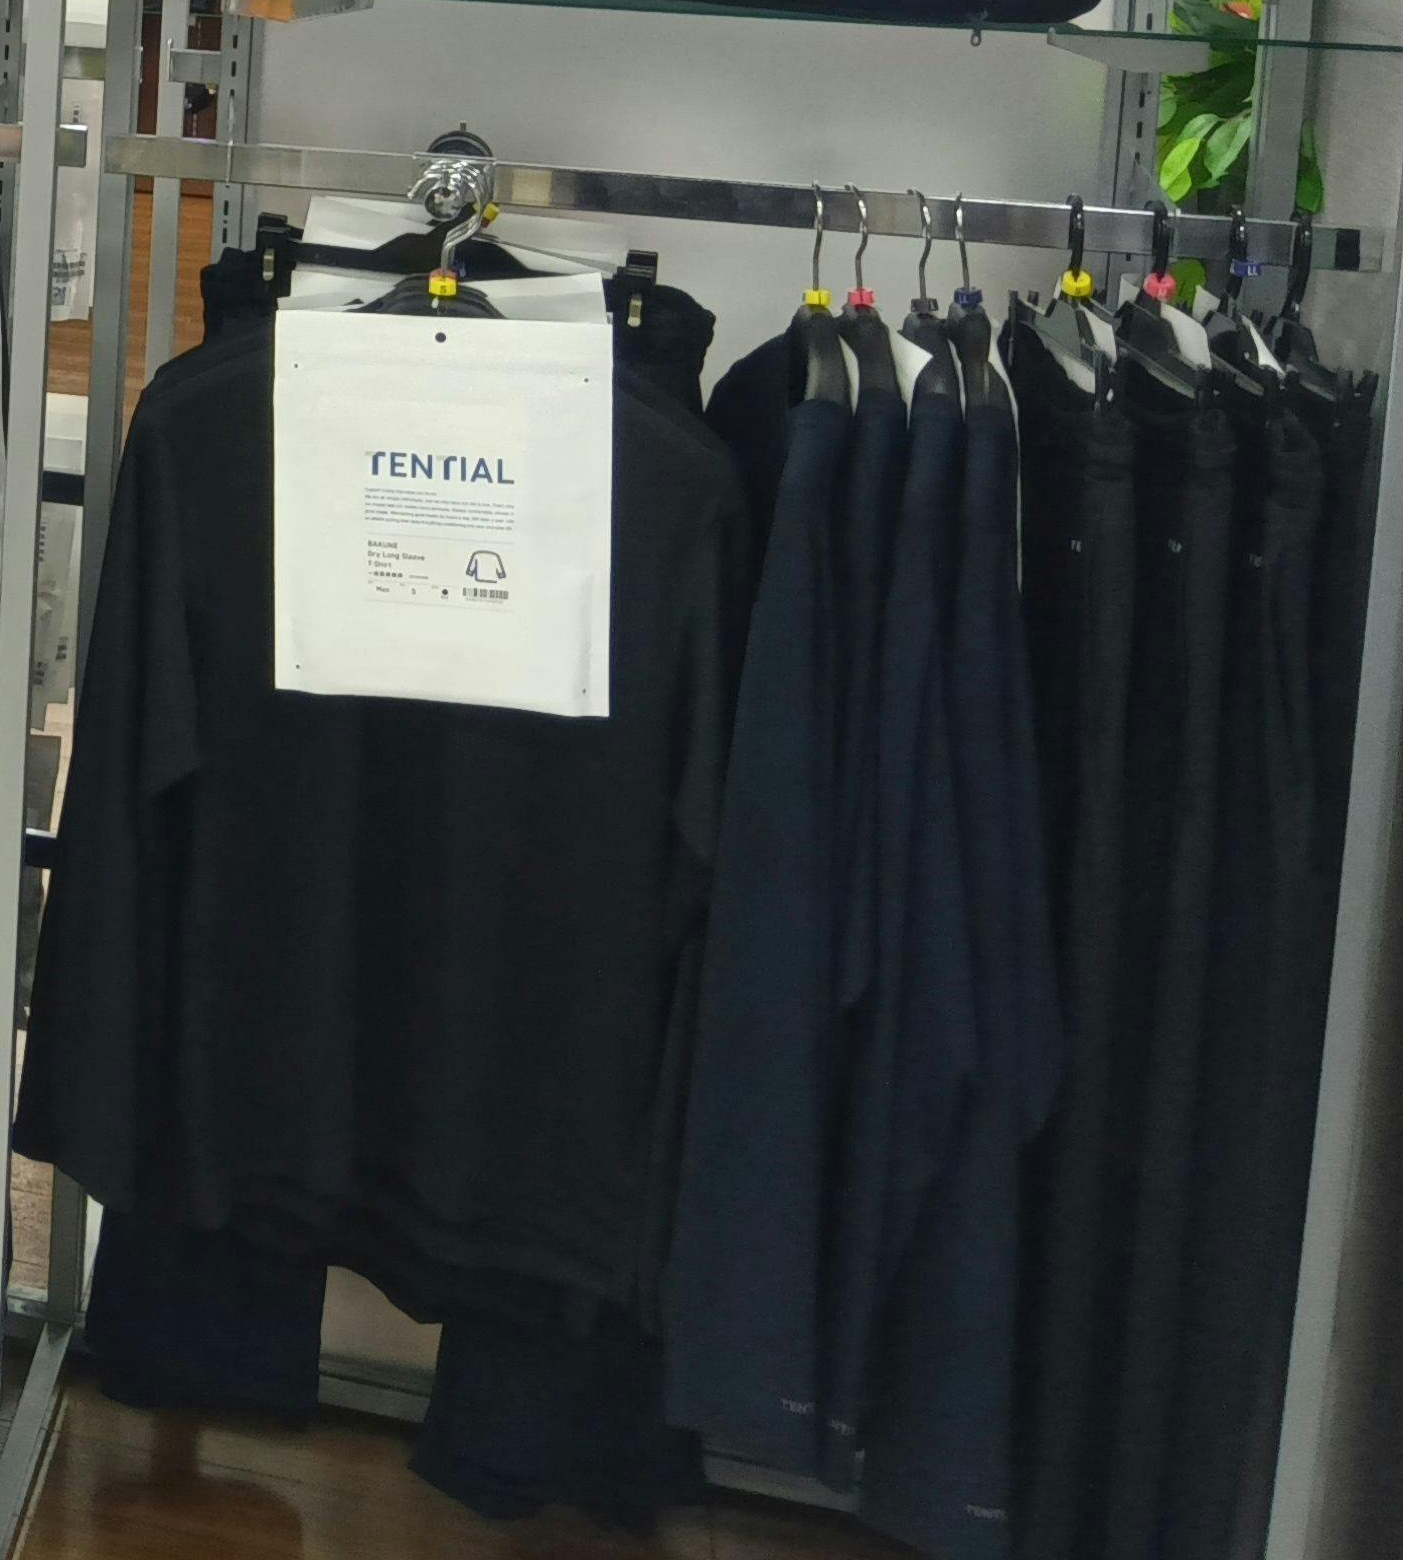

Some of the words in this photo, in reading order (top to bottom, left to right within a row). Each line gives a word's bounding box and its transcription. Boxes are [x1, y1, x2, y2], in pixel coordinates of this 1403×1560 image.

[365, 450, 515, 485] TENTIAL
[367, 540, 398, 550] BAKUNE
[383, 552, 400, 562] Long
